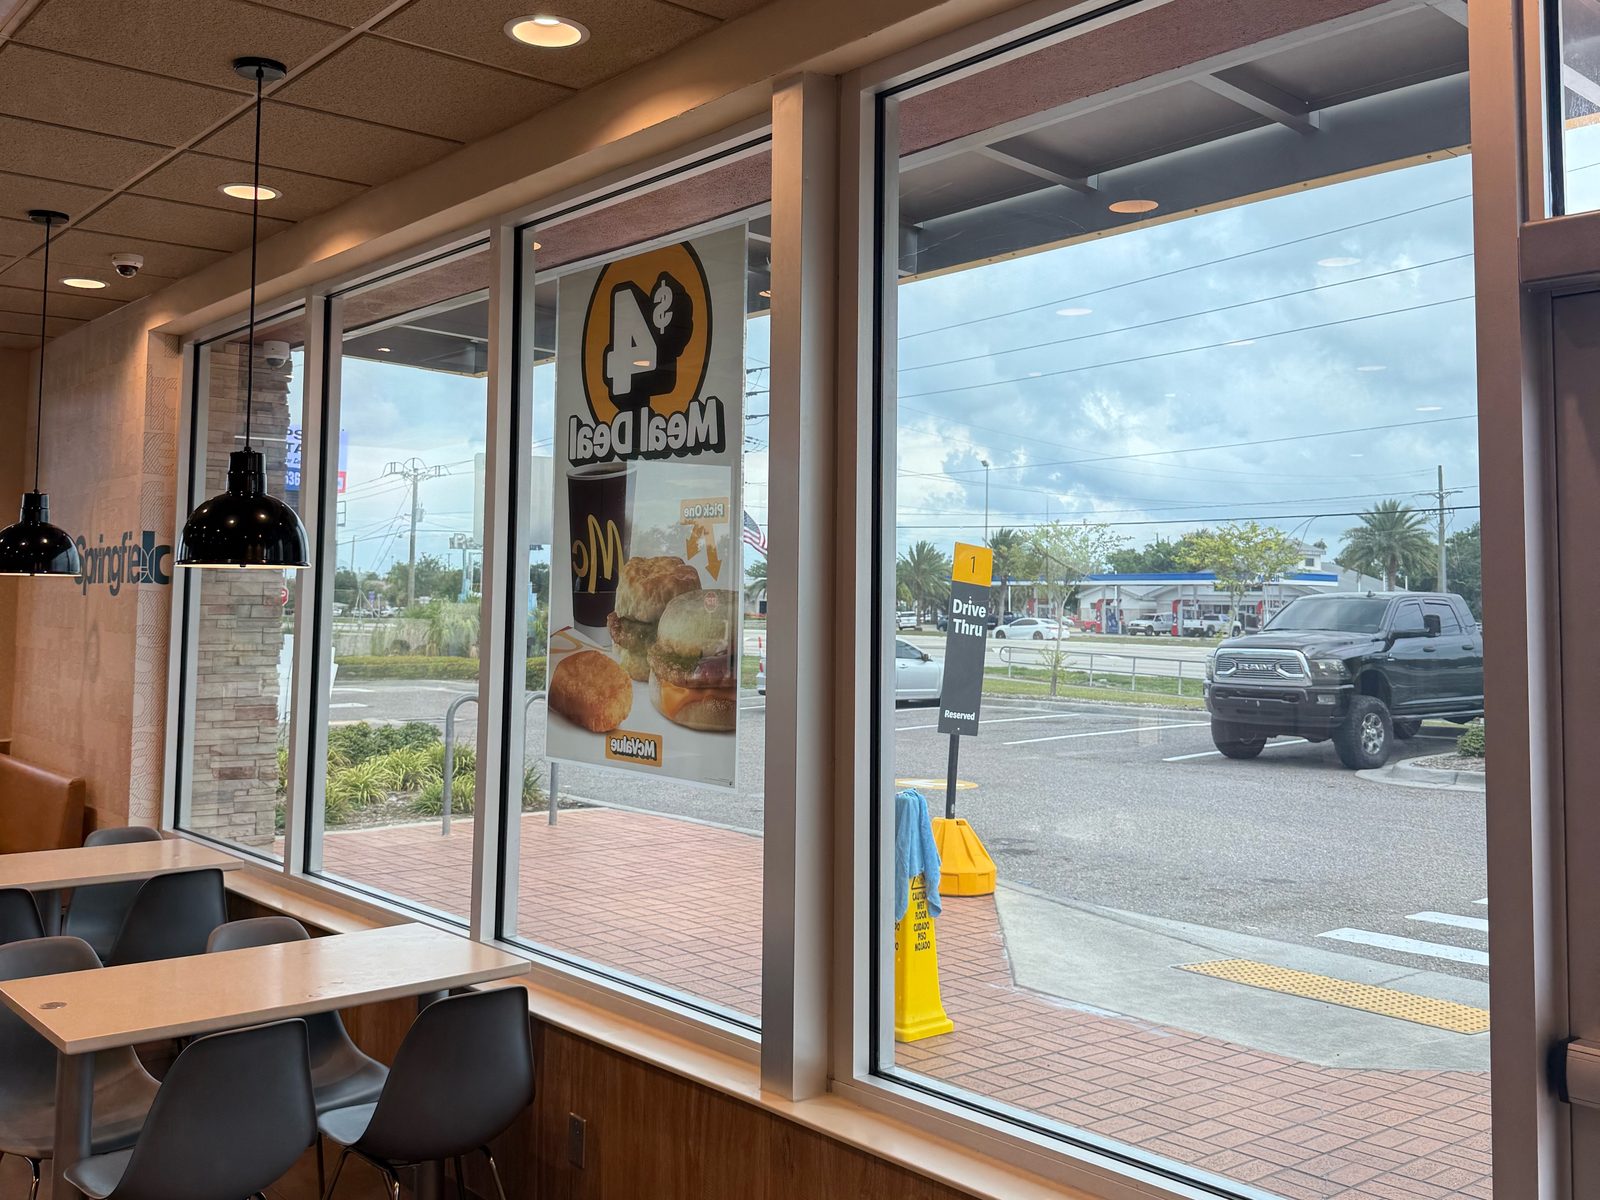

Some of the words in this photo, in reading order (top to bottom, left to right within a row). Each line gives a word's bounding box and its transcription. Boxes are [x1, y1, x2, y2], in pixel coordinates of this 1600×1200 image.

[970, 555, 976, 574] 1
[952, 597, 987, 619] Drive
[953, 618, 983, 637] Thru
[1238, 663, 1273, 671] RAM
[944, 709, 975, 720] Reserved
[917, 902, 925, 910] WET
[915, 911, 927, 920] FLOOR
[914, 922, 930, 932] CUIDADO
[918, 932, 927, 941] PISO
[915, 941, 930, 951] MOJADO
